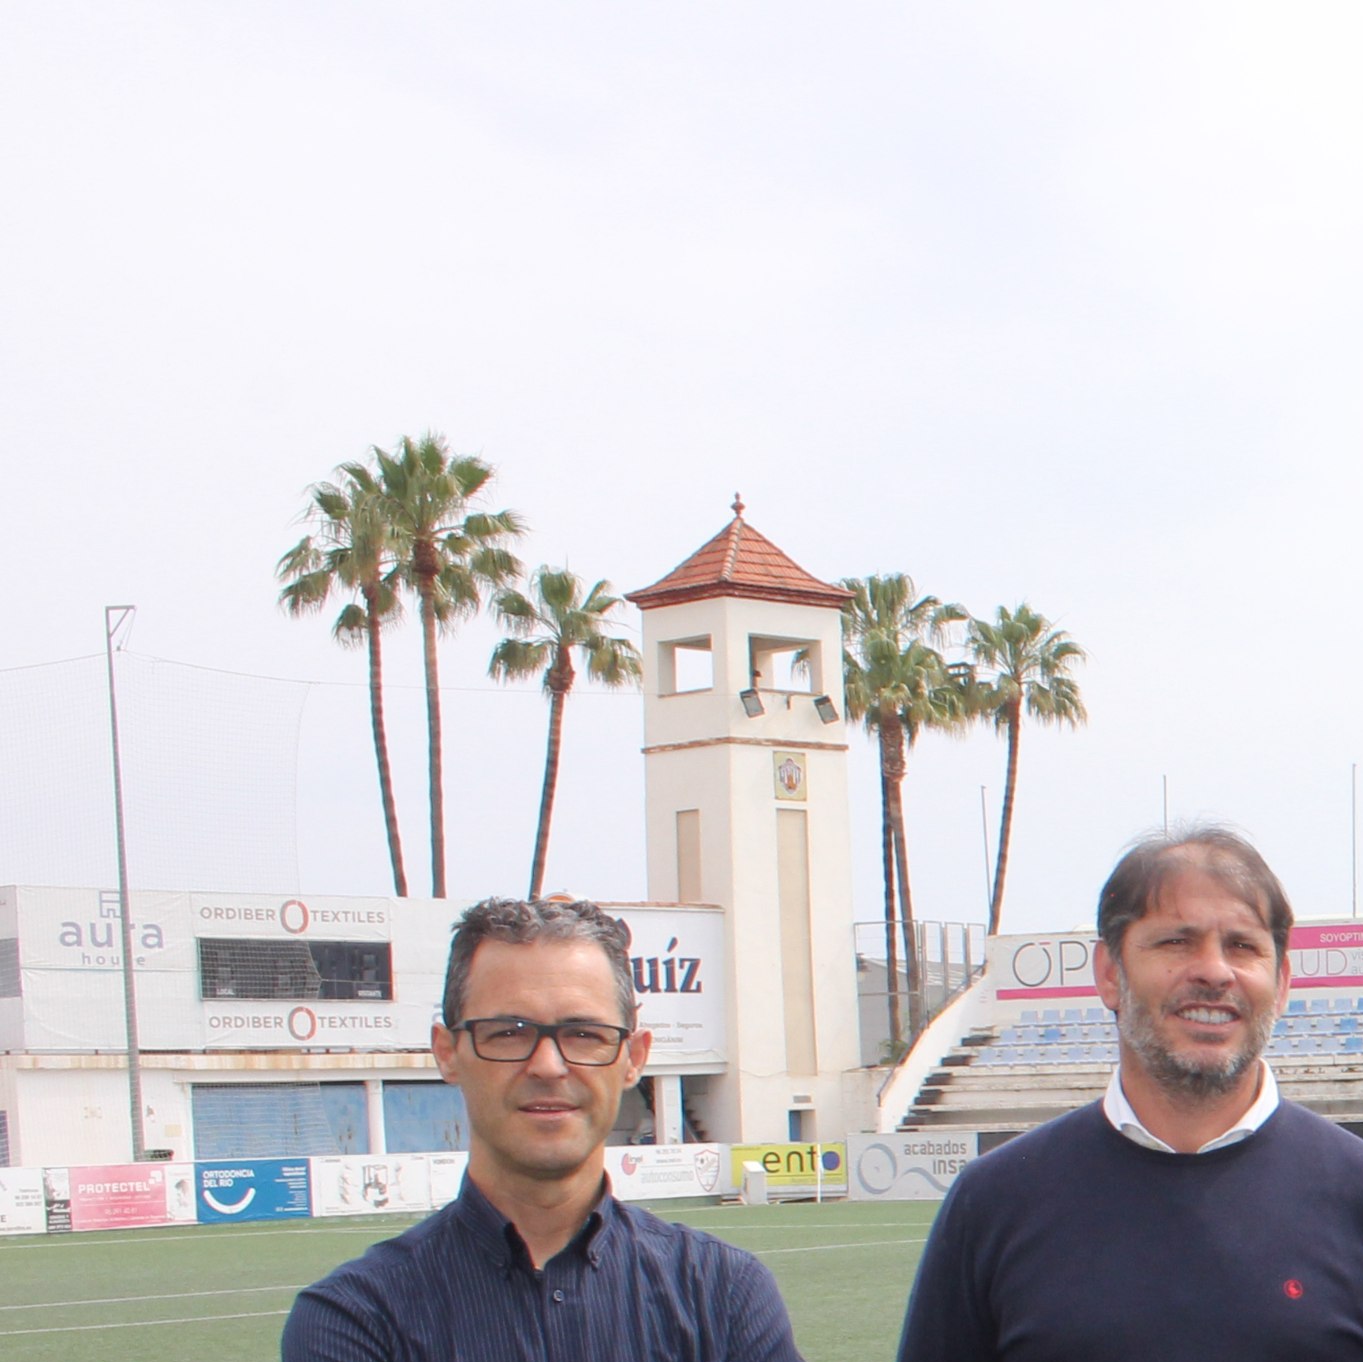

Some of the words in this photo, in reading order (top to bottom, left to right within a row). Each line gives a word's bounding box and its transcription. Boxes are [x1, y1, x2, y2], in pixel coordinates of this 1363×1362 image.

[199, 906, 276, 922] ORDIBER
[310, 909, 386, 925] TEXTILES
[59, 920, 165, 949] aua
[81, 952, 146, 967] houe
[208, 1014, 284, 1031] ORDIBER
[317, 1014, 393, 1031] TEXTILES
[903, 1140, 967, 1156] acabados
[202, 1169, 255, 1180] ORTODONCIA
[78, 1181, 151, 1195] PROTECTEL
[203, 1179, 219, 1188] DEL
